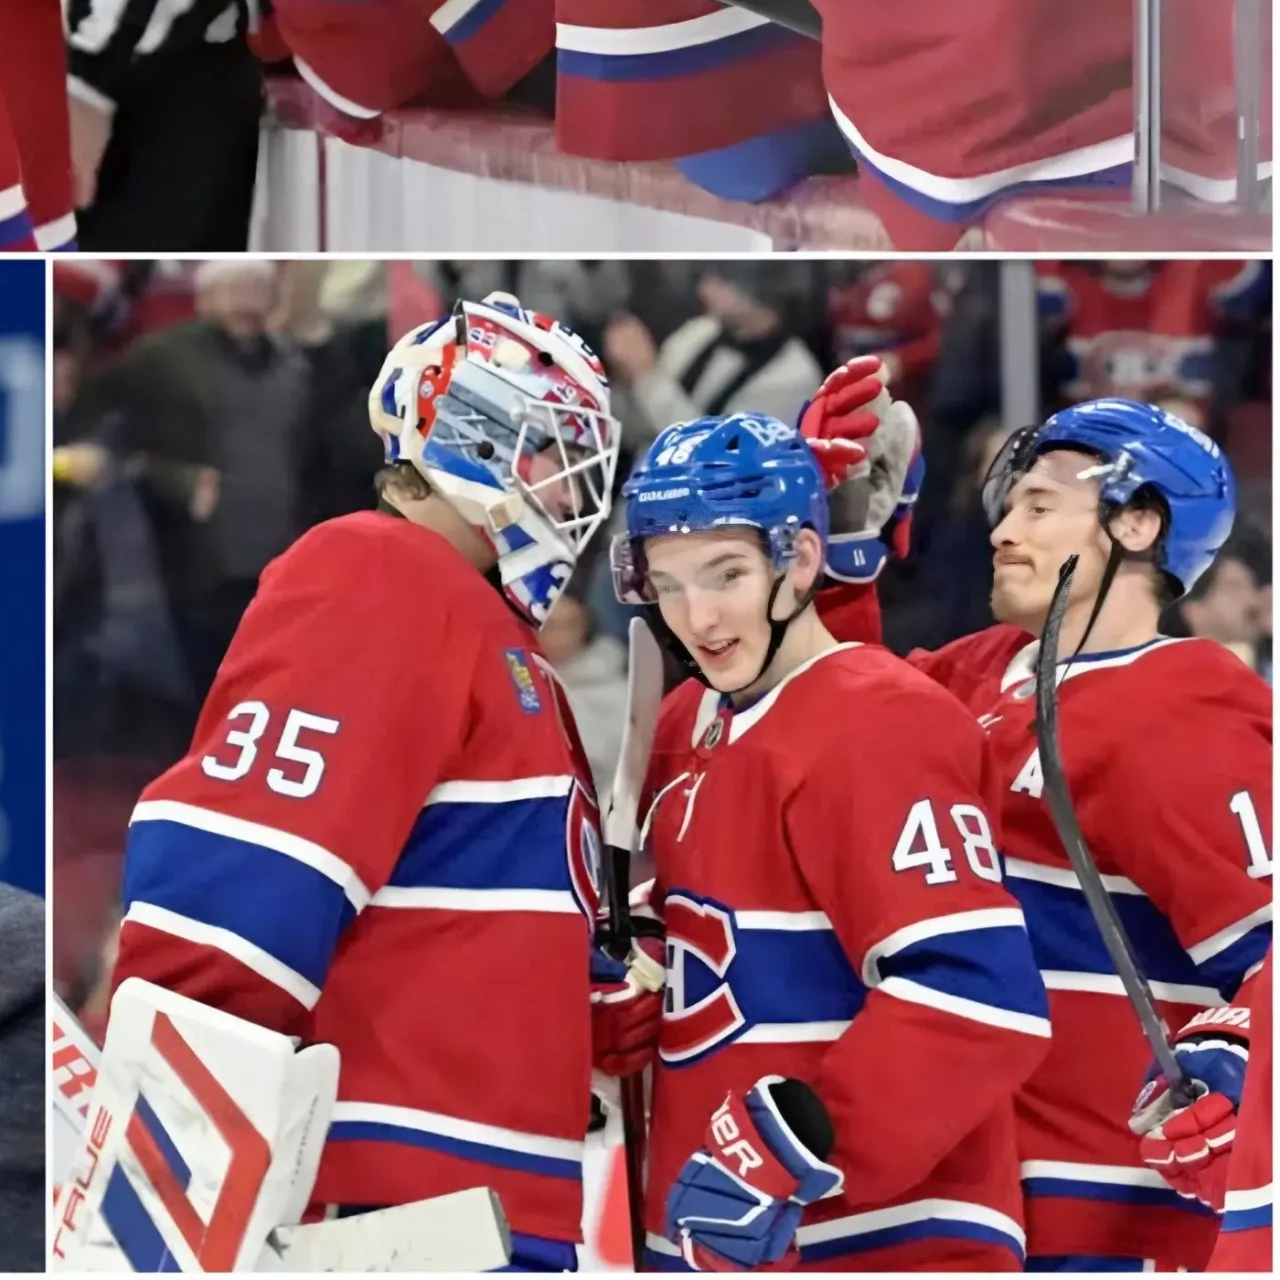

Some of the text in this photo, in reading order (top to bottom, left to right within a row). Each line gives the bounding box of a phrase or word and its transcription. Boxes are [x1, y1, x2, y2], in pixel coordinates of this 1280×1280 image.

[201, 701, 340, 799] 35
[892, 798, 1001, 885] 48
[52, 1105, 113, 1259] TRUE
